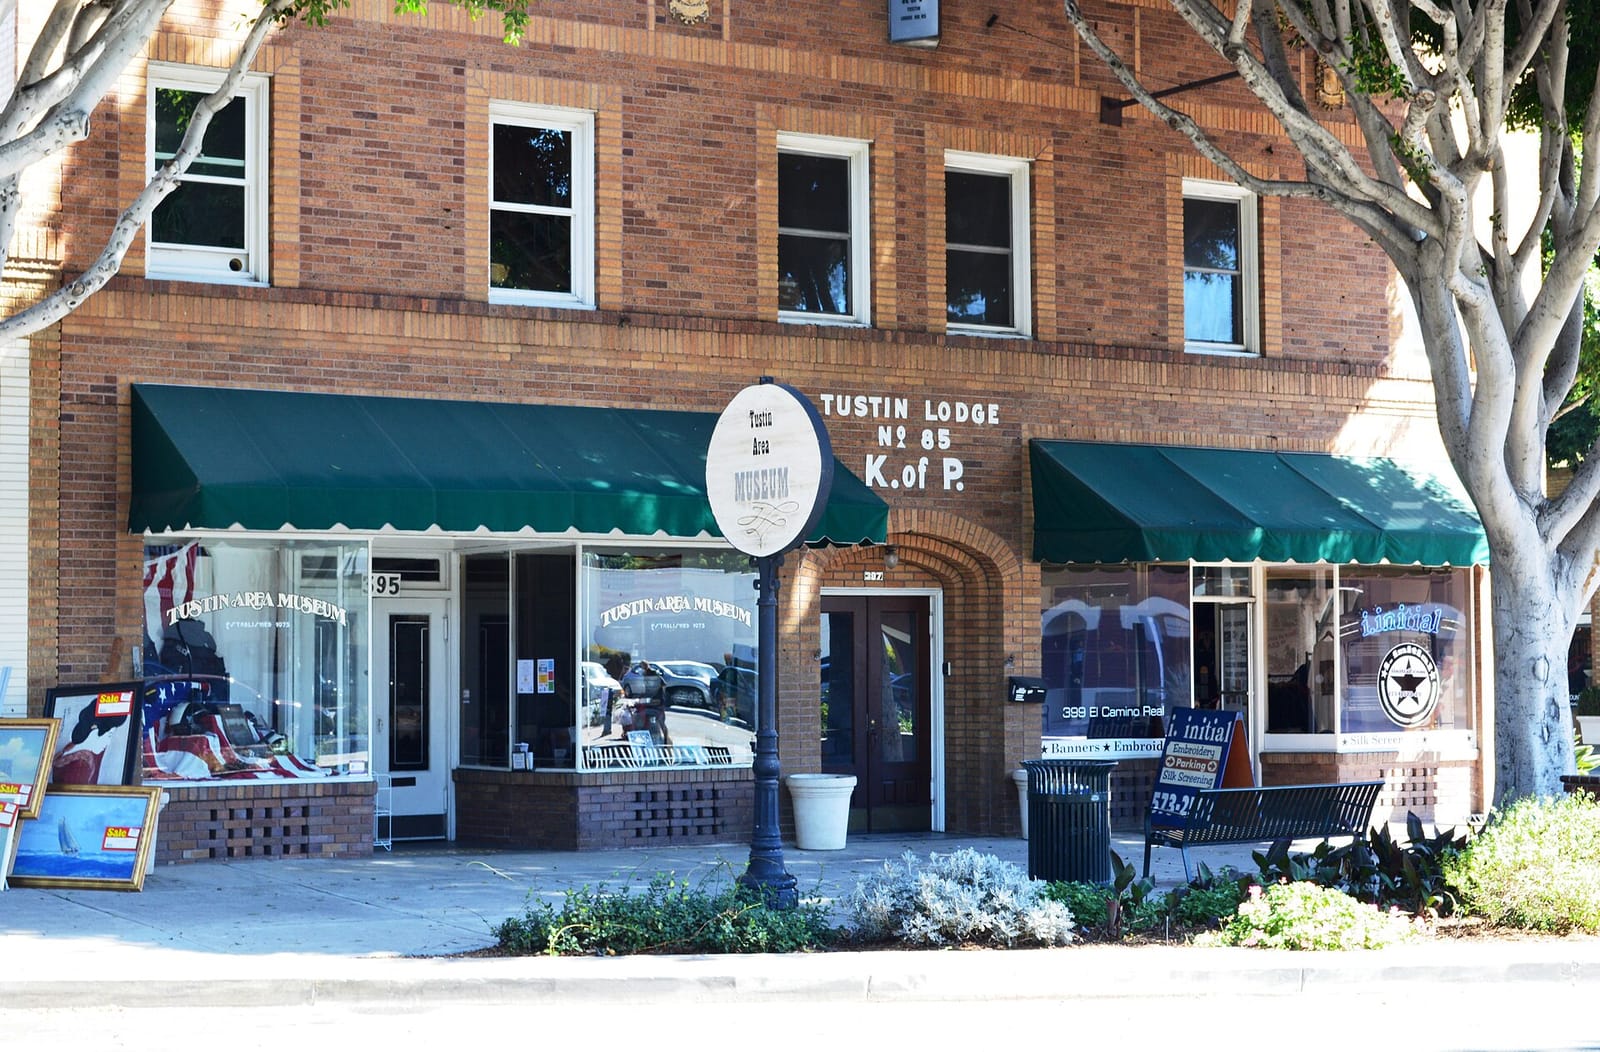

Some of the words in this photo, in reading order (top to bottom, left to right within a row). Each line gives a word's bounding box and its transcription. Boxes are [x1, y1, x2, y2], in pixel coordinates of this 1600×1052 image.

[820, 394, 908, 419] TUSTIN
[925, 400, 1000, 425] LODGE
[749, 408, 773, 429] Tustin
[752, 437, 770, 456] Area
[921, 428, 951, 450] 85
[942, 457, 965, 491] P.
[734, 466, 789, 502] MUSEUM
[166, 594, 231, 627] TUSTIN
[231, 591, 275, 611] AREA
[277, 592, 347, 627] MUSEUM
[600, 598, 653, 628] TUSTIN
[654, 596, 691, 613] AREA
[694, 597, 752, 628] MUSEUM
[100, 694, 119, 703] Sale
[1062, 706, 1086, 718] 399
[1089, 706, 1099, 717] El
[1101, 706, 1140, 717] Camino
[1142, 705, 1165, 717] Real
[1184, 715, 1232, 743] initial
[1051, 742, 1100, 754] Banners
[1350, 736, 1368, 745] Silk
[1173, 743, 1215, 759] Embroidery
[1176, 758, 1206, 772] Parking
[1162, 770, 1177, 780] Silk
[1177, 772, 1213, 786] Screening
[0, 784, 18, 793] Sale
[107, 828, 127, 837] Sale
